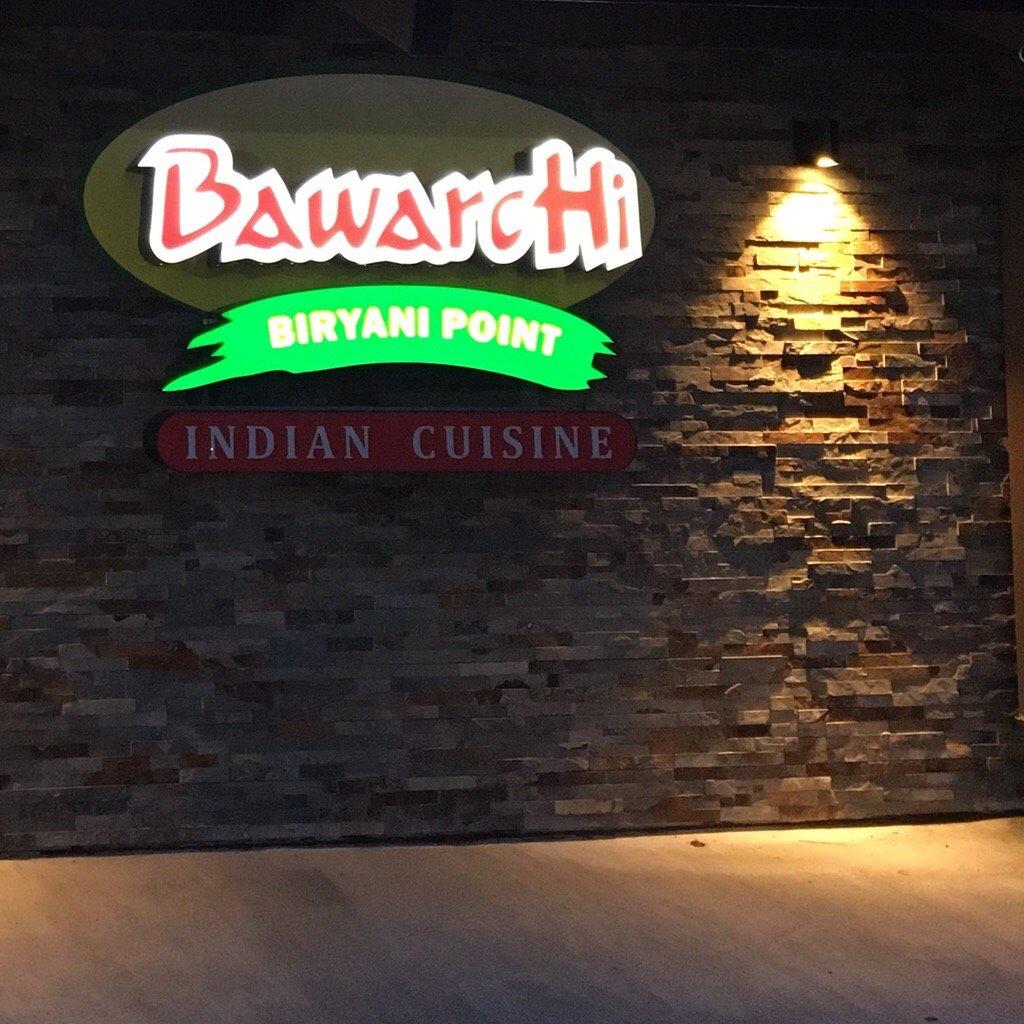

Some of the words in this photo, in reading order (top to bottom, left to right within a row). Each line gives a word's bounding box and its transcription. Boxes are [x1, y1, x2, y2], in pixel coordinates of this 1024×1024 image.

[267, 306, 430, 349] BIRYANI
[441, 308, 563, 356] POINT
[185, 425, 372, 460] INDIAN
[412, 425, 614, 461] CUISINE
